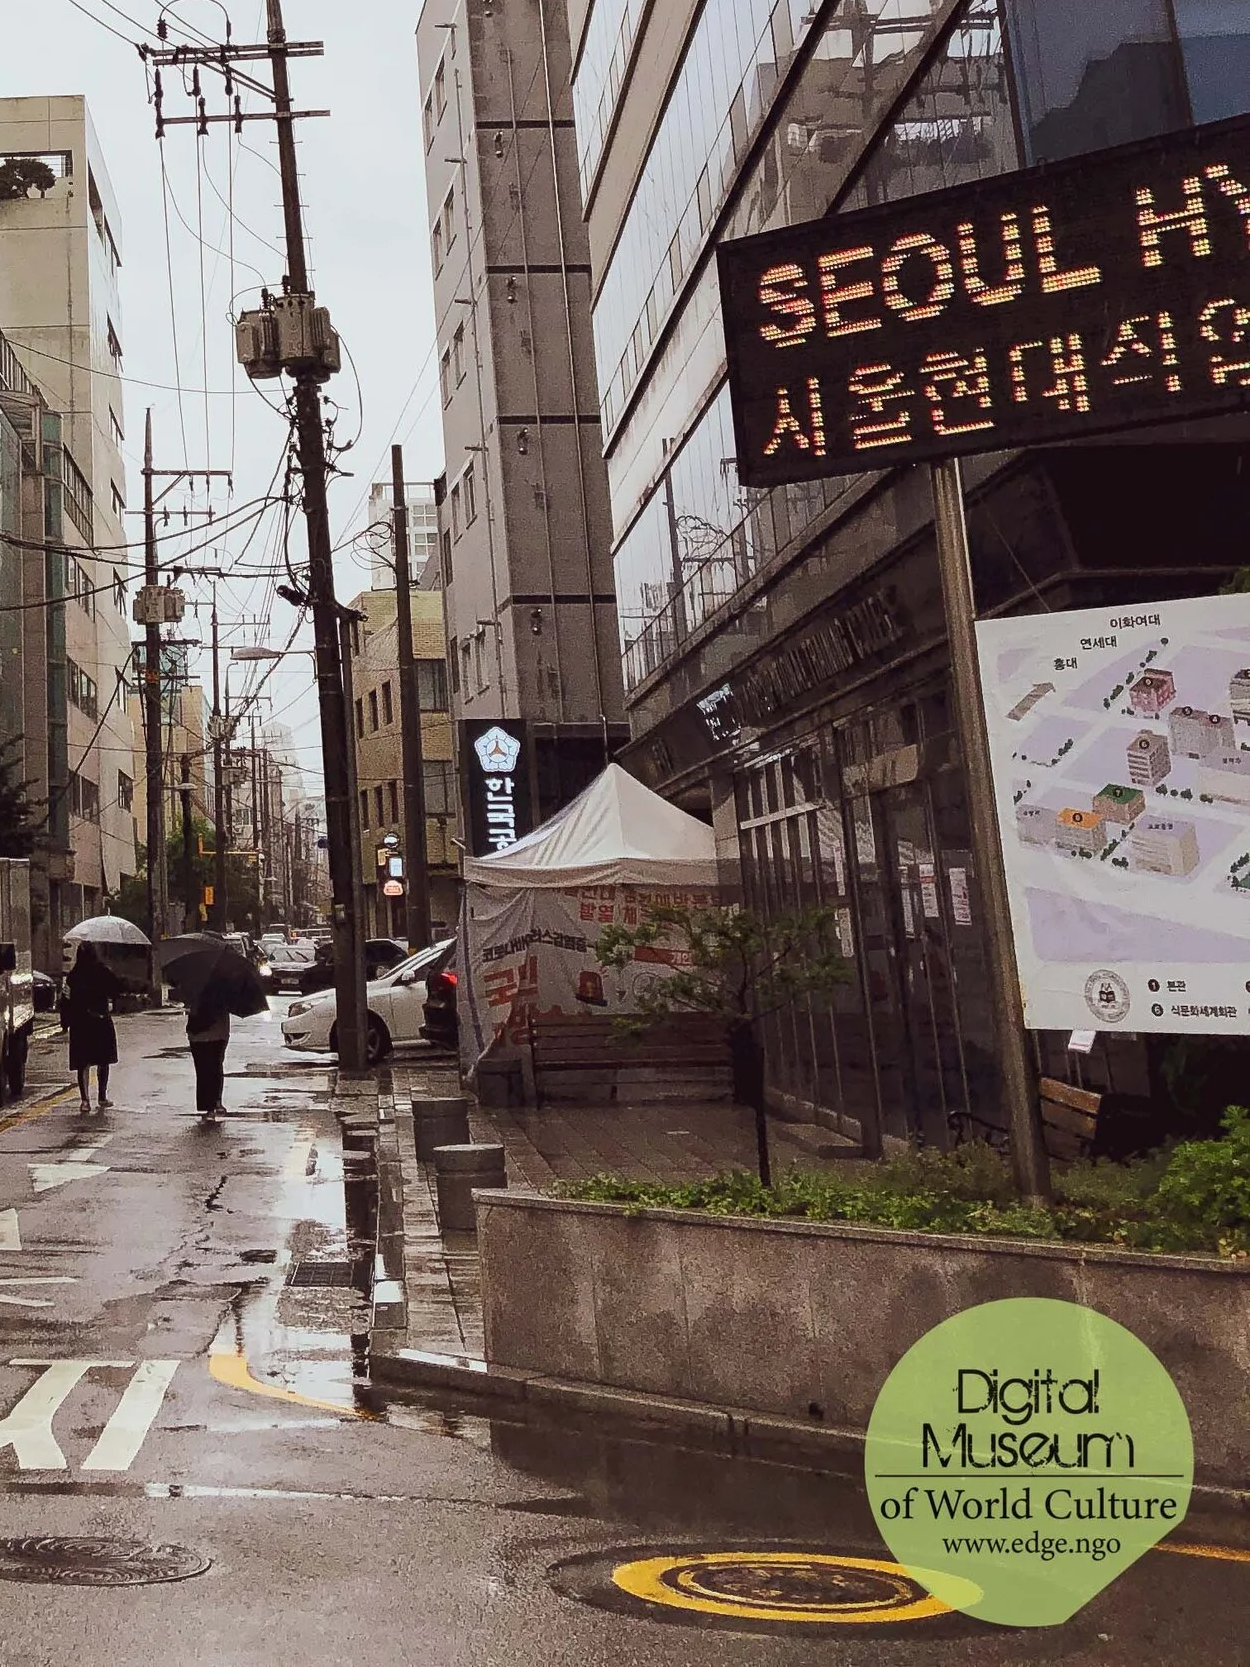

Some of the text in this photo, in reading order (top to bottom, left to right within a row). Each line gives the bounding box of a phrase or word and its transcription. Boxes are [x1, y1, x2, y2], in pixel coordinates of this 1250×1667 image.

[759, 206, 1102, 348] SEOUL
[1110, 614, 1161, 629] 이화여대
[1080, 635, 1117, 650] 연세대
[1053, 657, 1078, 671] 홍대
